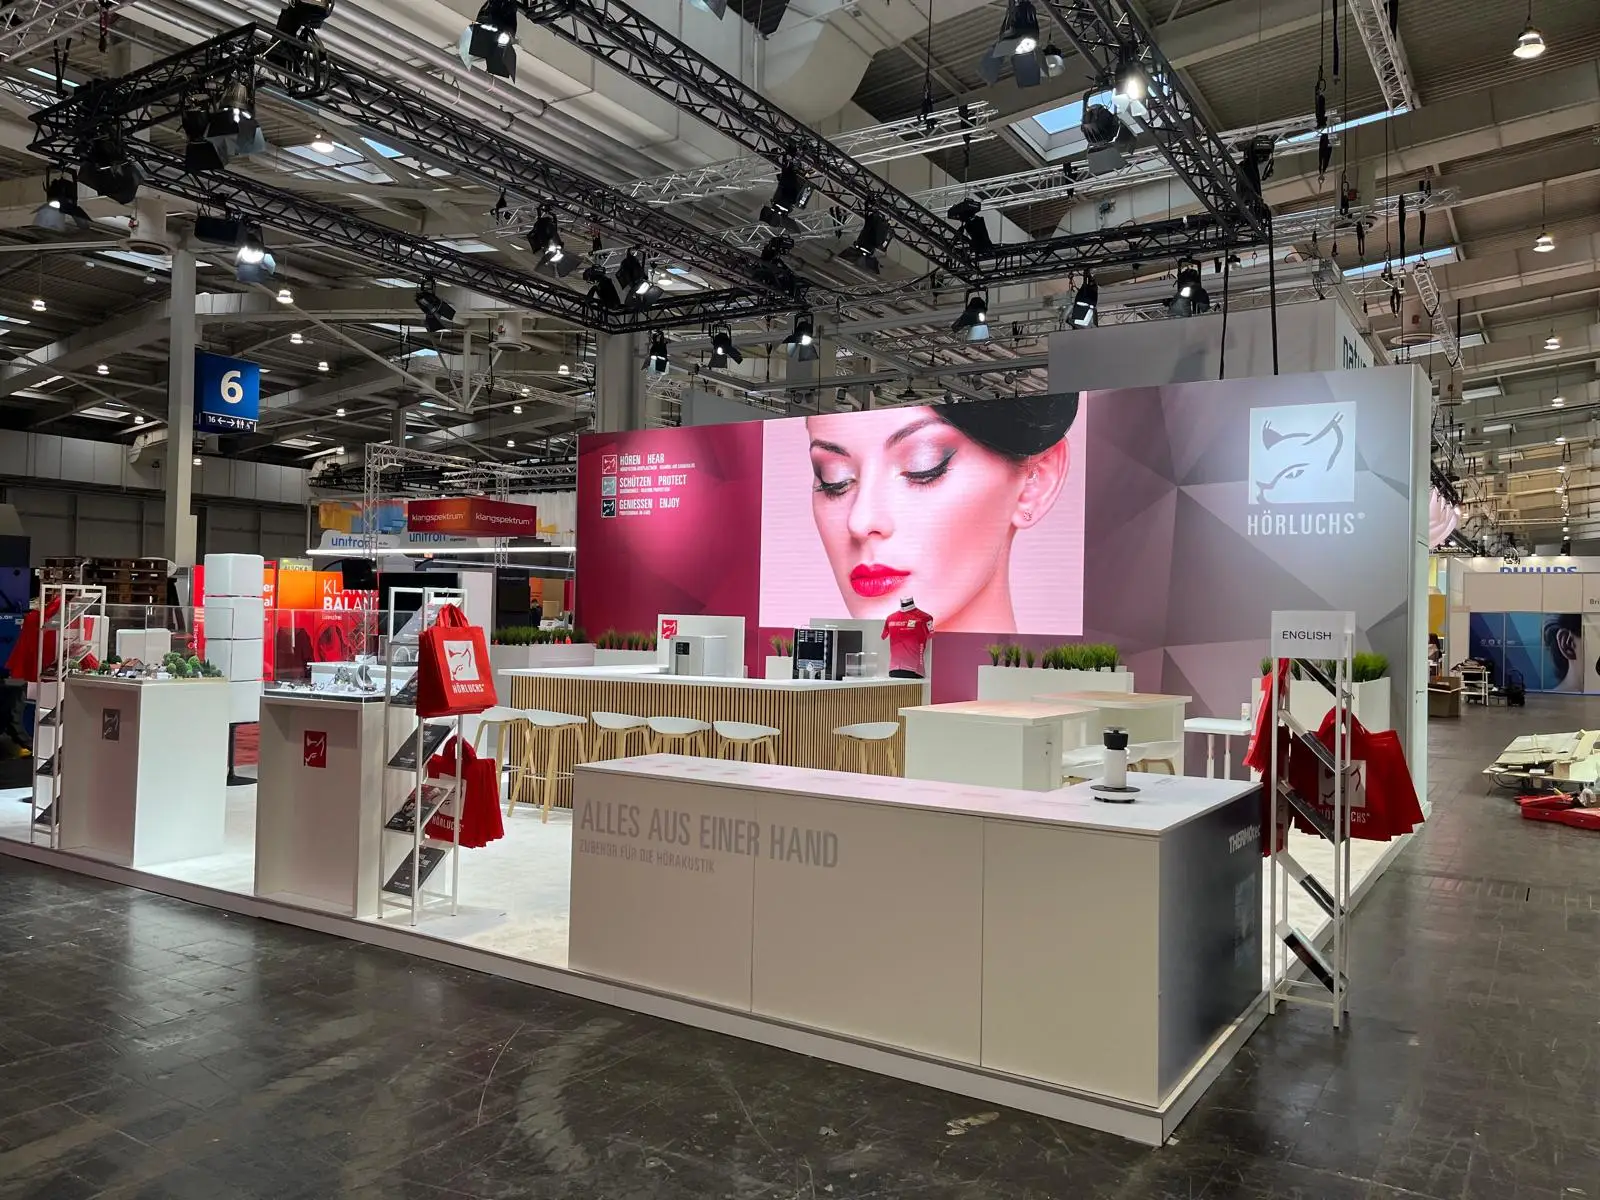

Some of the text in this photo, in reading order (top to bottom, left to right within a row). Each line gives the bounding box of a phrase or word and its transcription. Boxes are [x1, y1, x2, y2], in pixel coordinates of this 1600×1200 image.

[221, 370, 243, 404] 6
[620, 453, 665, 465] HÖREN HEAR
[619, 474, 687, 487] SCHÜTZEN PROTECT
[619, 497, 680, 510] GENIESSEN ENJOY
[1282, 630, 1332, 641] ENGLISH
[580, 798, 839, 869] ALLES AUS EINER HAND
[620, 843, 637, 860] FÜR
[639, 847, 654, 864] DIE
